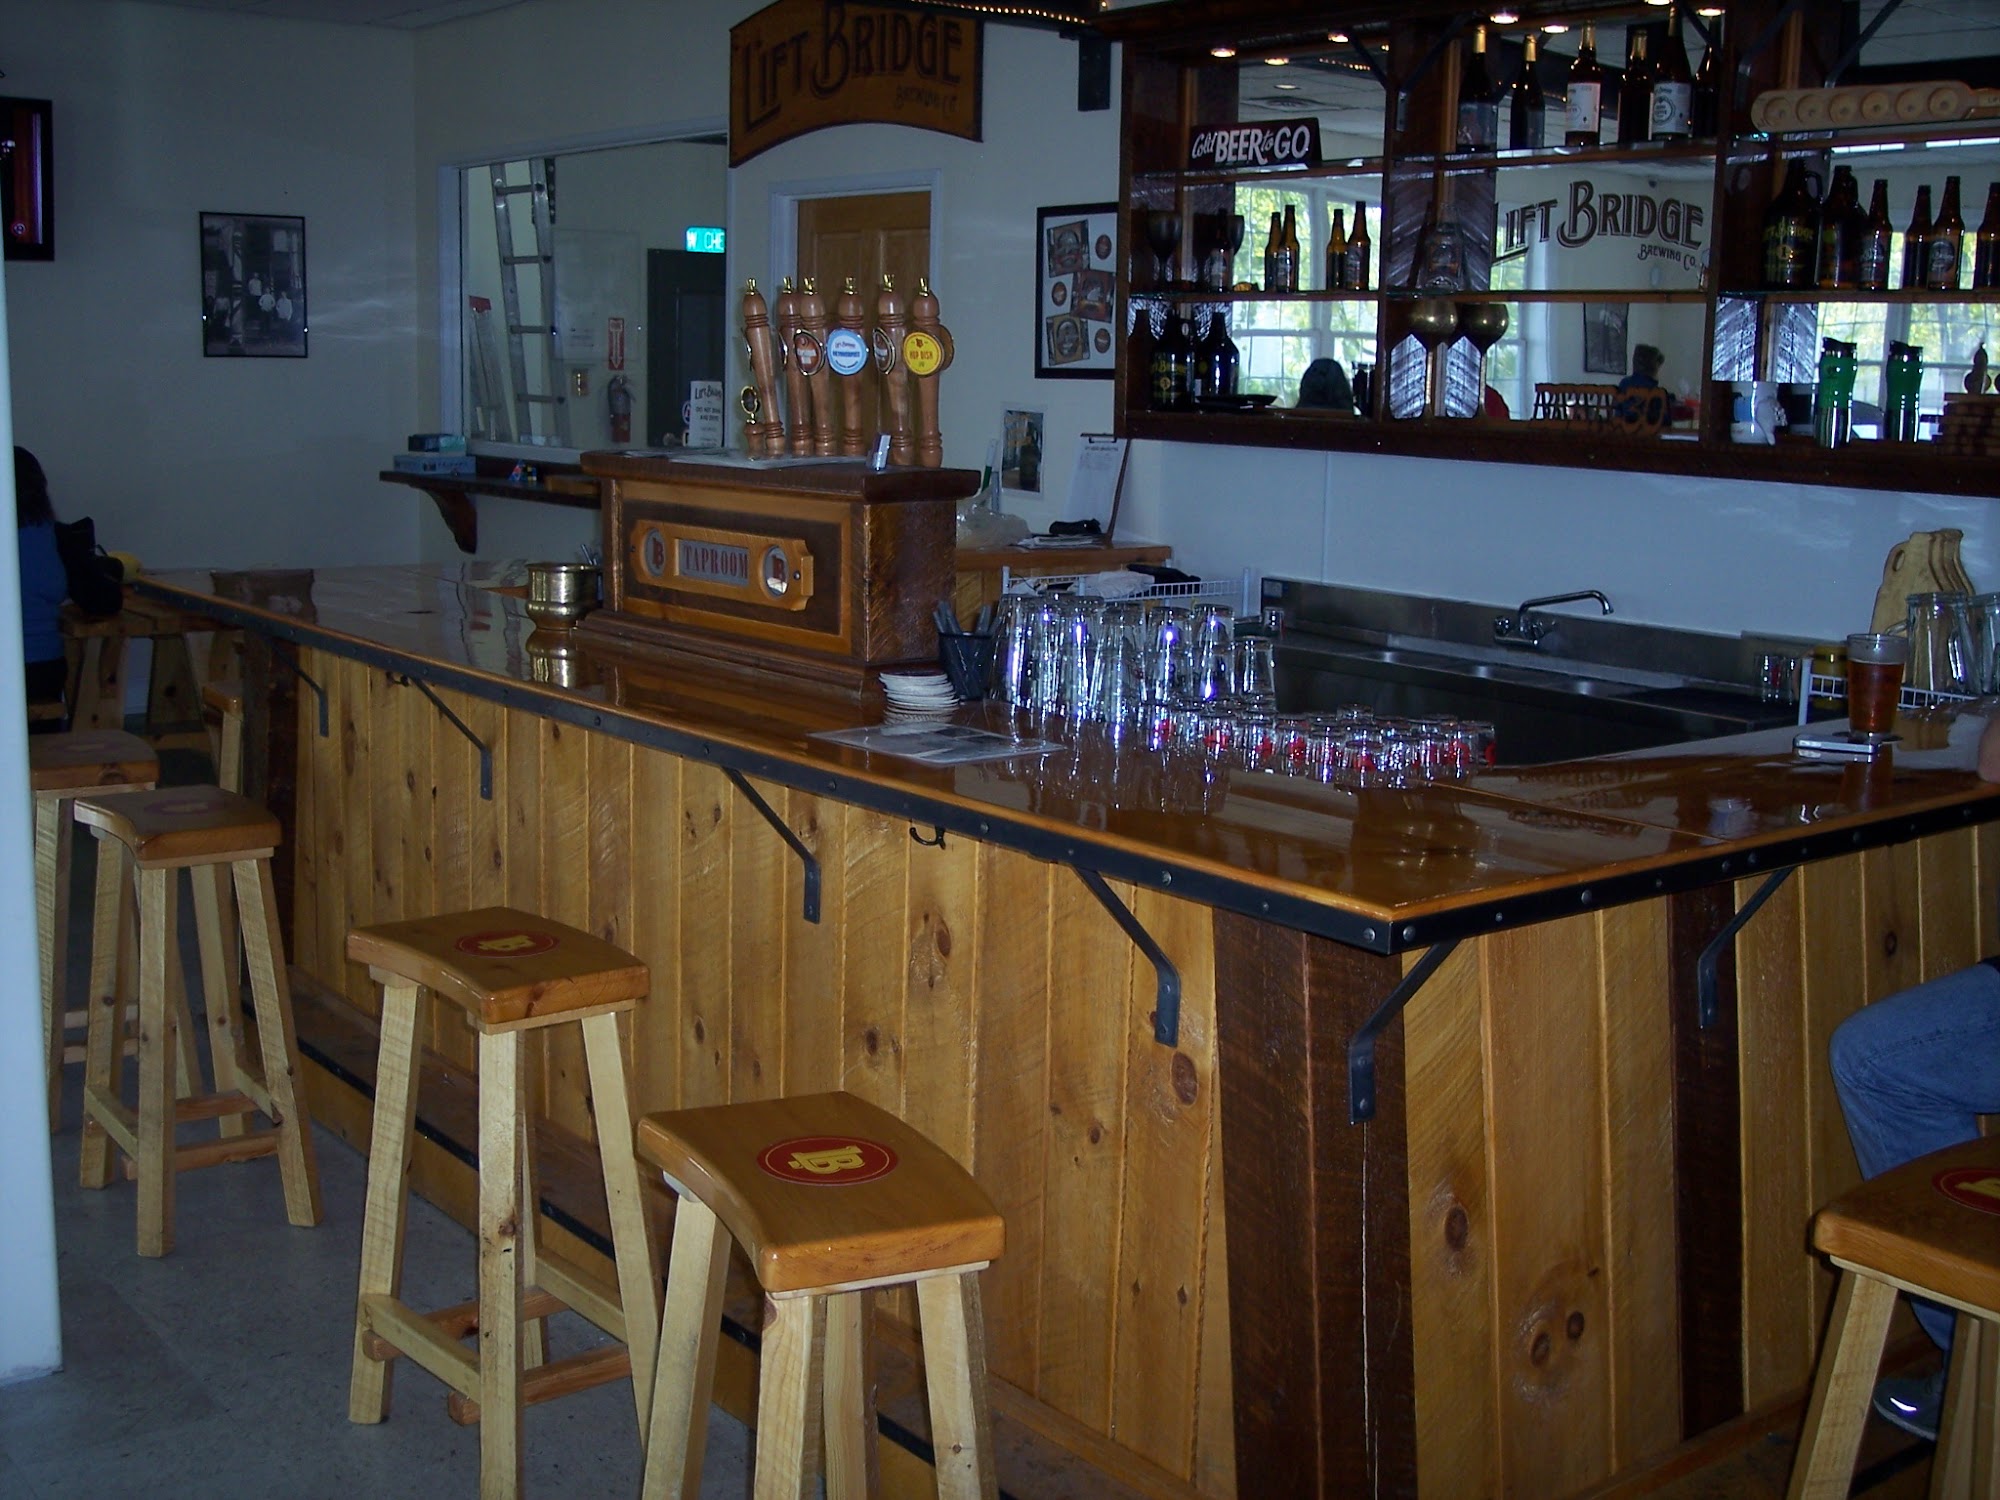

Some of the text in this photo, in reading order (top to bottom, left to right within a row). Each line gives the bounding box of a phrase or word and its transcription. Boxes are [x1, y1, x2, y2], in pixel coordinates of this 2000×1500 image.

[741, 1, 962, 131] LIFT BRIDGE
[1214, 128, 1268, 165] BEER
[1273, 124, 1311, 160] GO
[1556, 180, 1704, 250] BRIDGE
[1637, 243, 1681, 261] BREWING
[683, 544, 749, 580] TAPROOM
